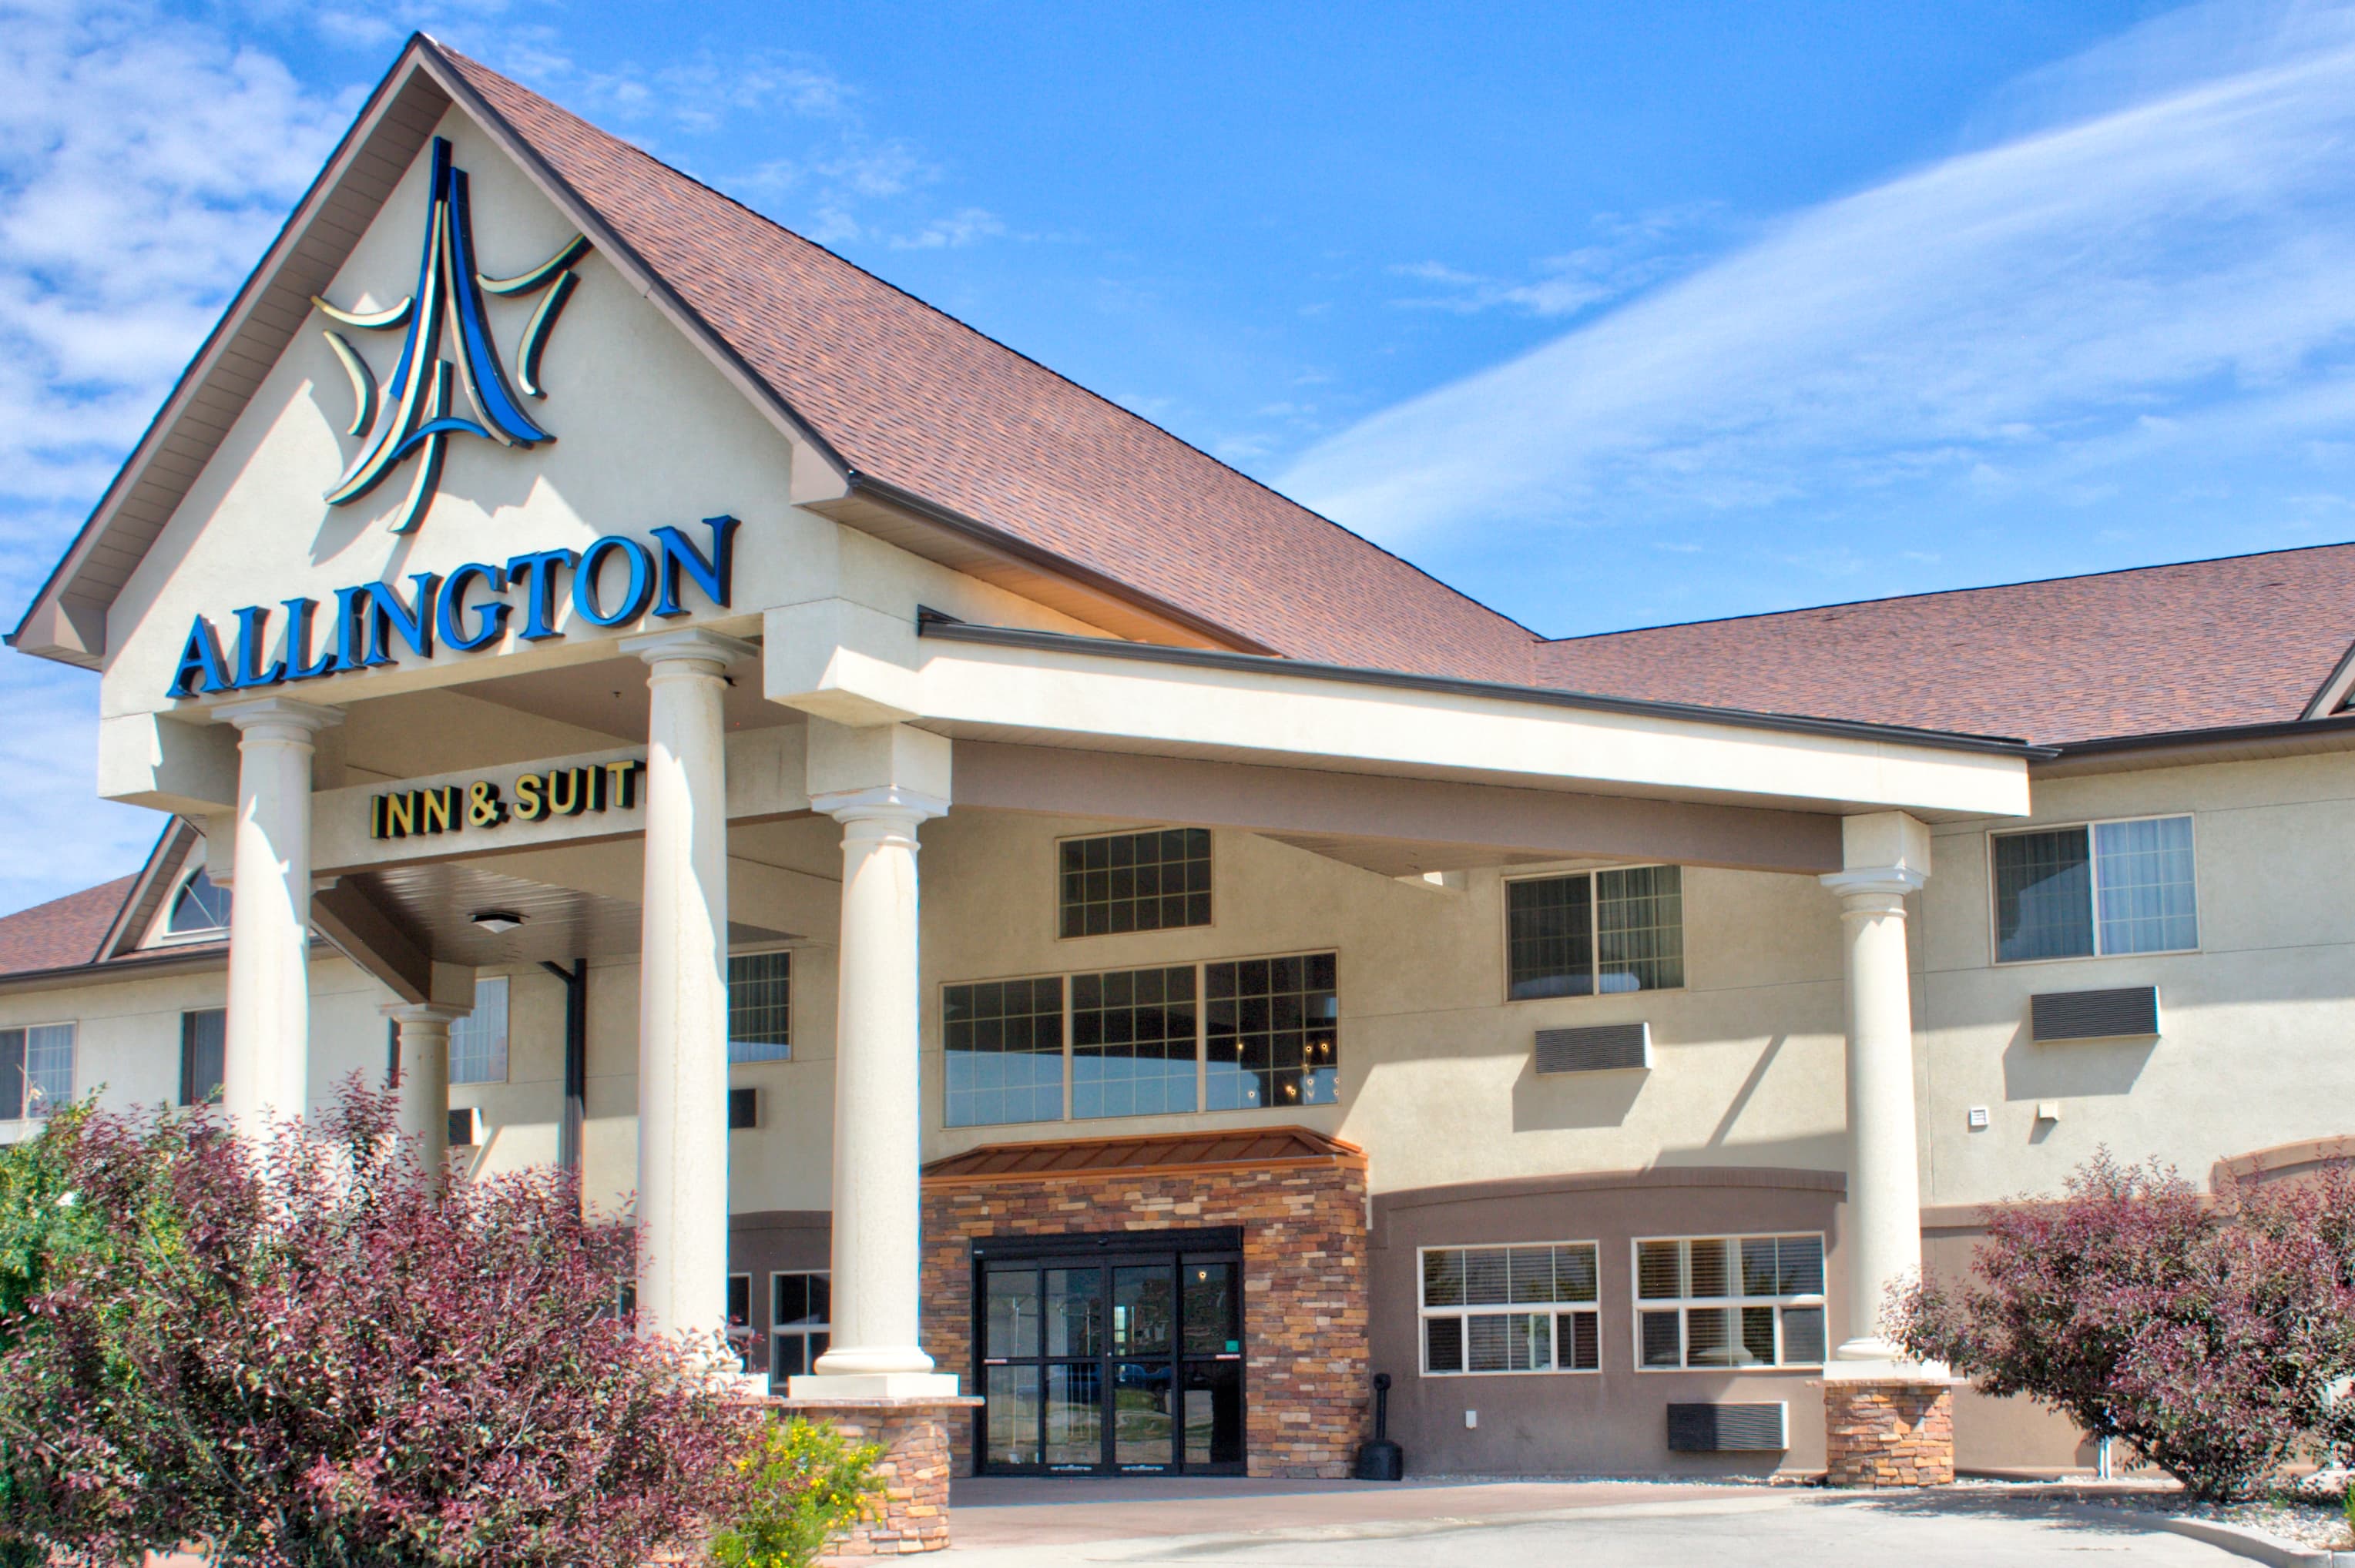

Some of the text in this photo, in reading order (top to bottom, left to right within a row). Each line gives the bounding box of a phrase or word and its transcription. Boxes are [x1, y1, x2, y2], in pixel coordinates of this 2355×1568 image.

[165, 514, 741, 699] ALLINGTON
[370, 758, 649, 839] INN & SUIT
